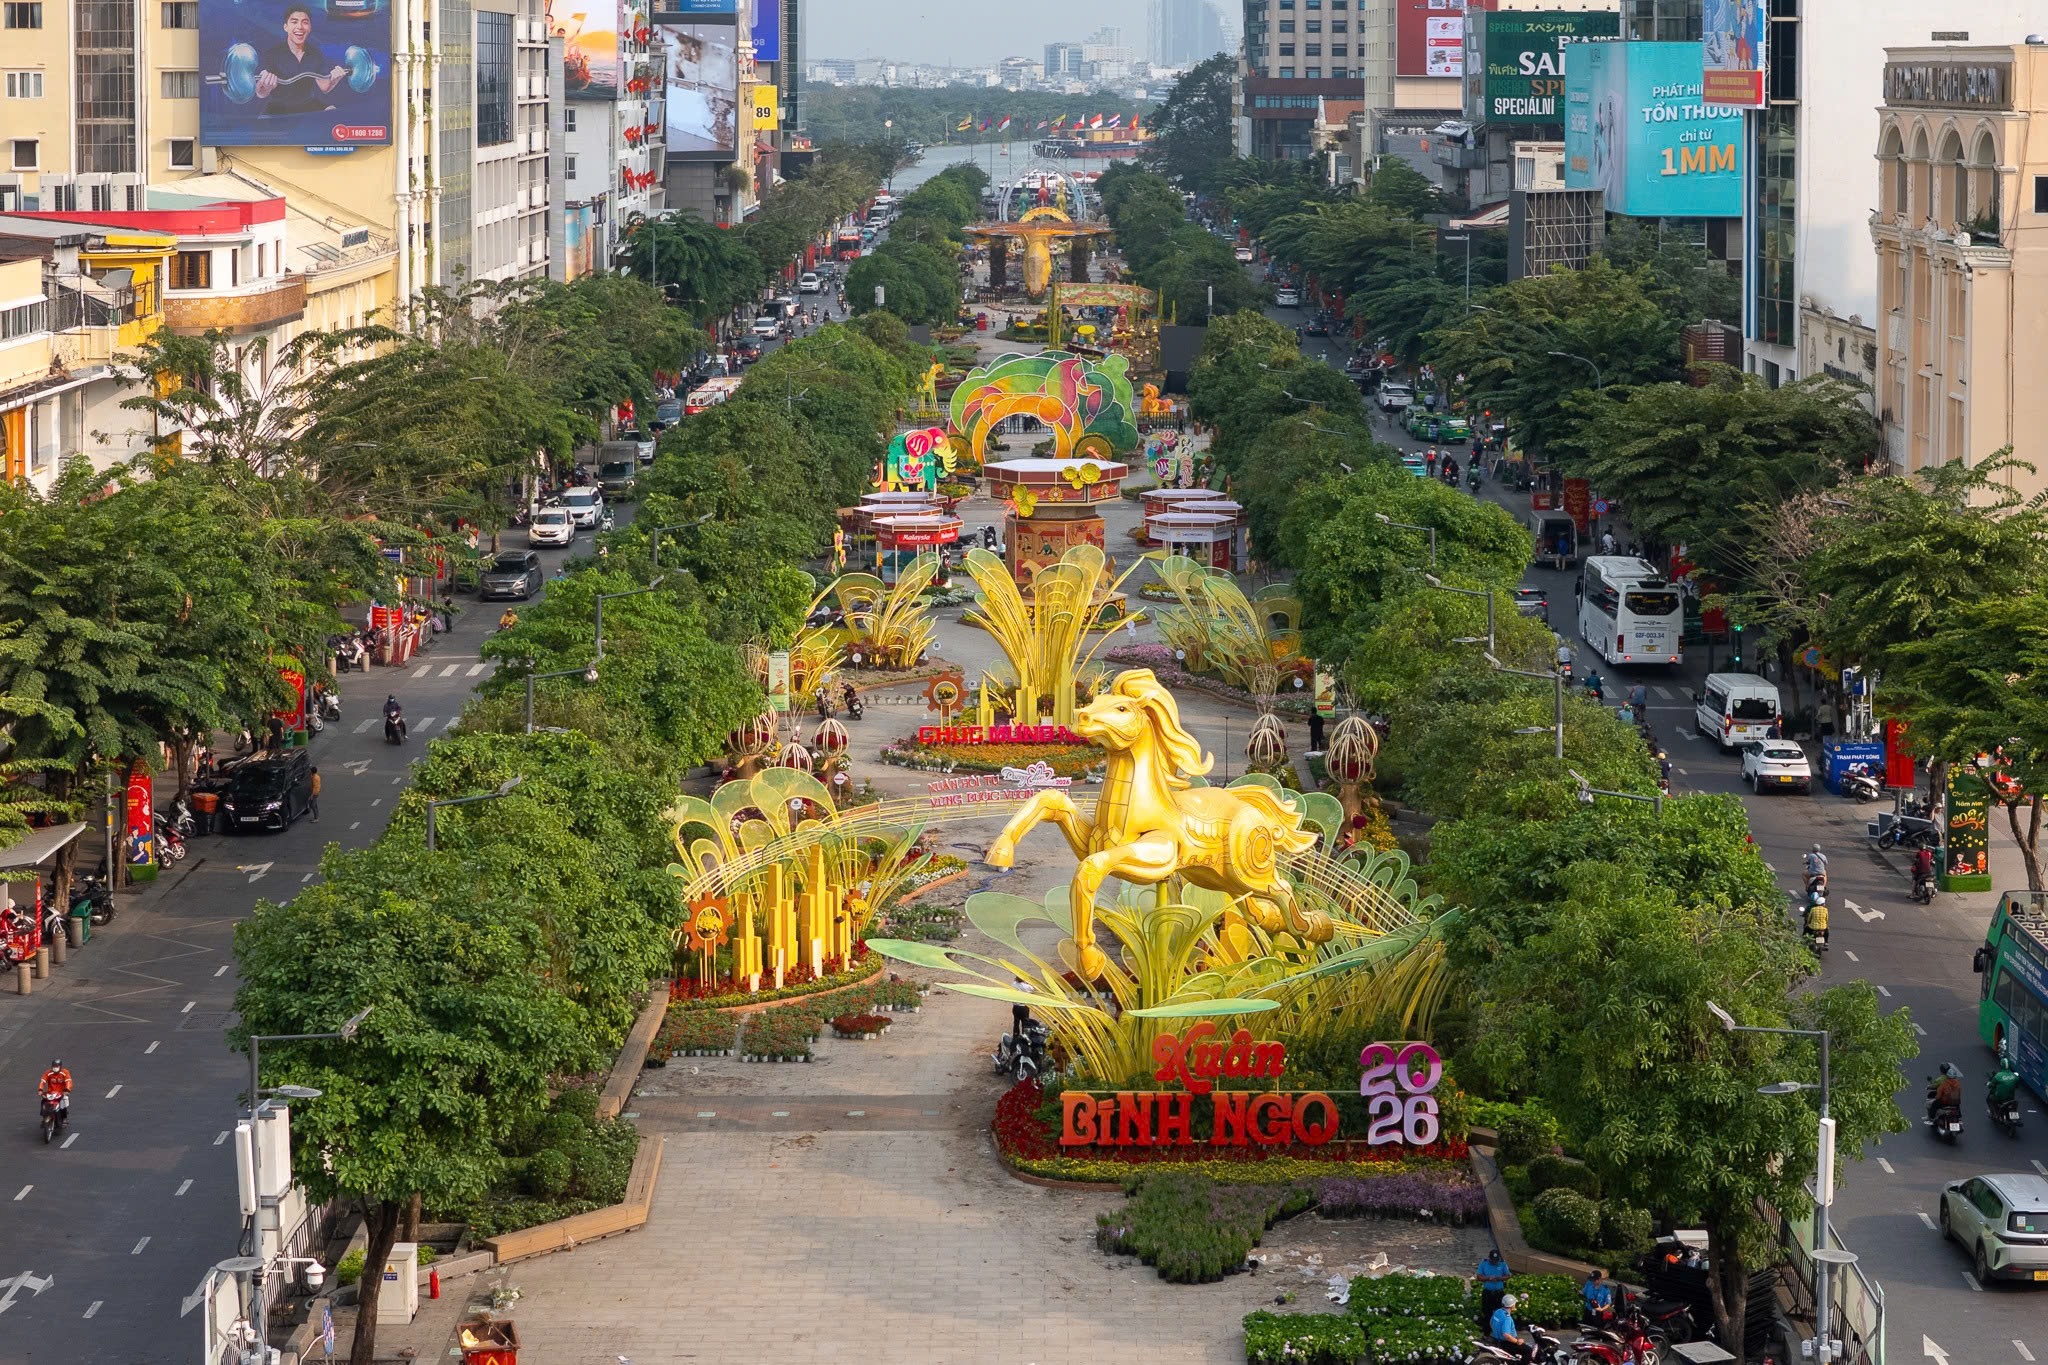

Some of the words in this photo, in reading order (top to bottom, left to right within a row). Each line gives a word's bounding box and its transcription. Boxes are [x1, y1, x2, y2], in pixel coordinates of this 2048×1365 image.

[1525, 22, 1575, 33] スペシャル
[1652, 83, 1685, 98] PHÁT
[1687, 81, 1704, 96] HI
[756, 107, 771, 118] 89
[1494, 96, 1555, 115] SPECIÁLNÍ
[1642, 102, 1678, 123] TỔN
[1660, 144, 1735, 176] 1MM
[902, 533, 931, 542] Malaysia
[918, 722, 983, 743] CHÚC
[1152, 1020, 1286, 1095] Xuân
[1359, 1042, 1443, 1098] 20
[1367, 1094, 1440, 1146] 26
